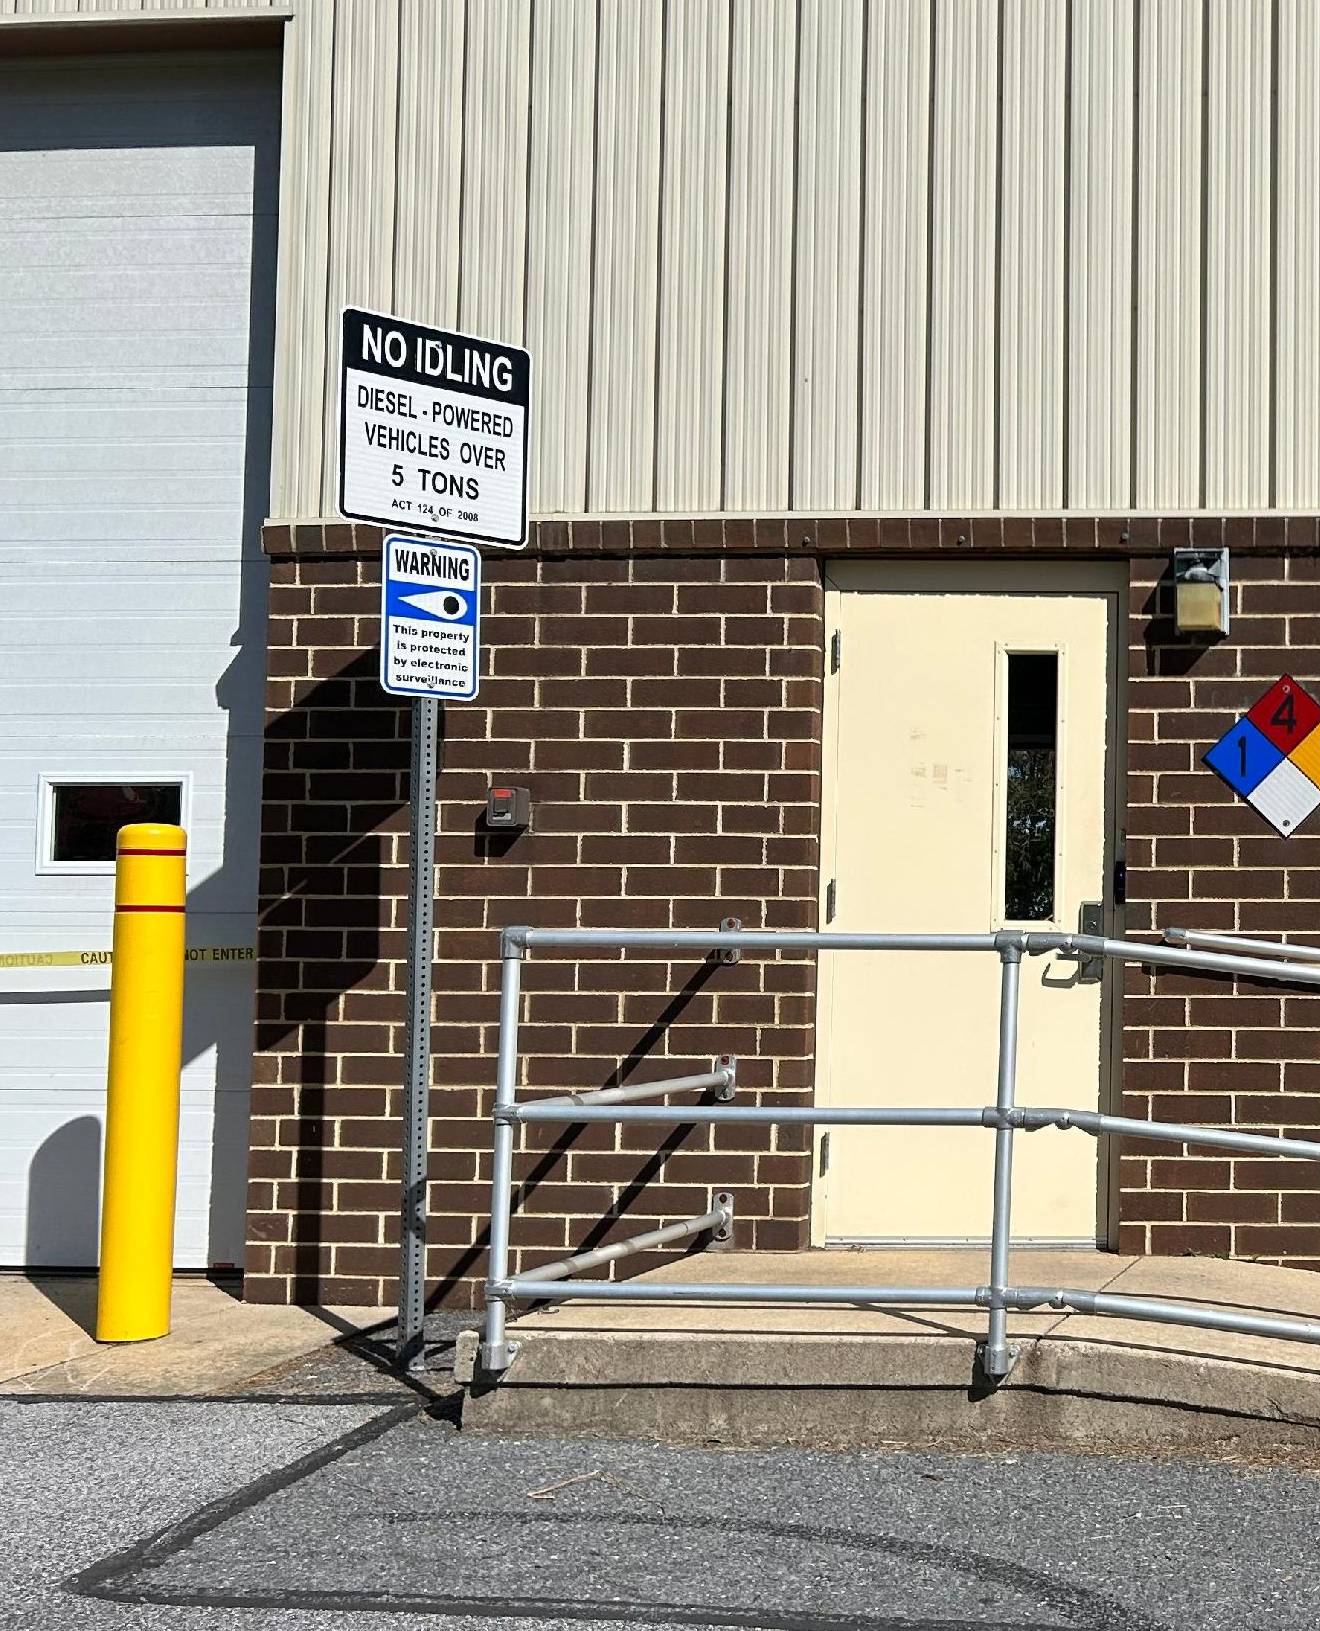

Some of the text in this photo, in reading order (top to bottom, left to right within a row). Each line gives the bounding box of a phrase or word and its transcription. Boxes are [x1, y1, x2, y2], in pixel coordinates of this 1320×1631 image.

[361, 323, 513, 392] NO IDLING
[357, 384, 418, 420] DIESEL
[432, 401, 514, 438] POWERED
[364, 421, 506, 472] VEHICLES OVER
[391, 464, 480, 501] 5 TONS
[391, 499, 479, 522] ACT 124 OF 2008
[394, 548, 470, 582] WARNING
[392, 624, 470, 644] This property
[396, 640, 466, 656] is protected
[393, 656, 469, 672] by electronic
[395, 674, 466, 688] surveillance
[1270, 693, 1297, 735] 4
[1237, 735, 1247, 778] 1
[212, 947, 254, 961] ENTER
